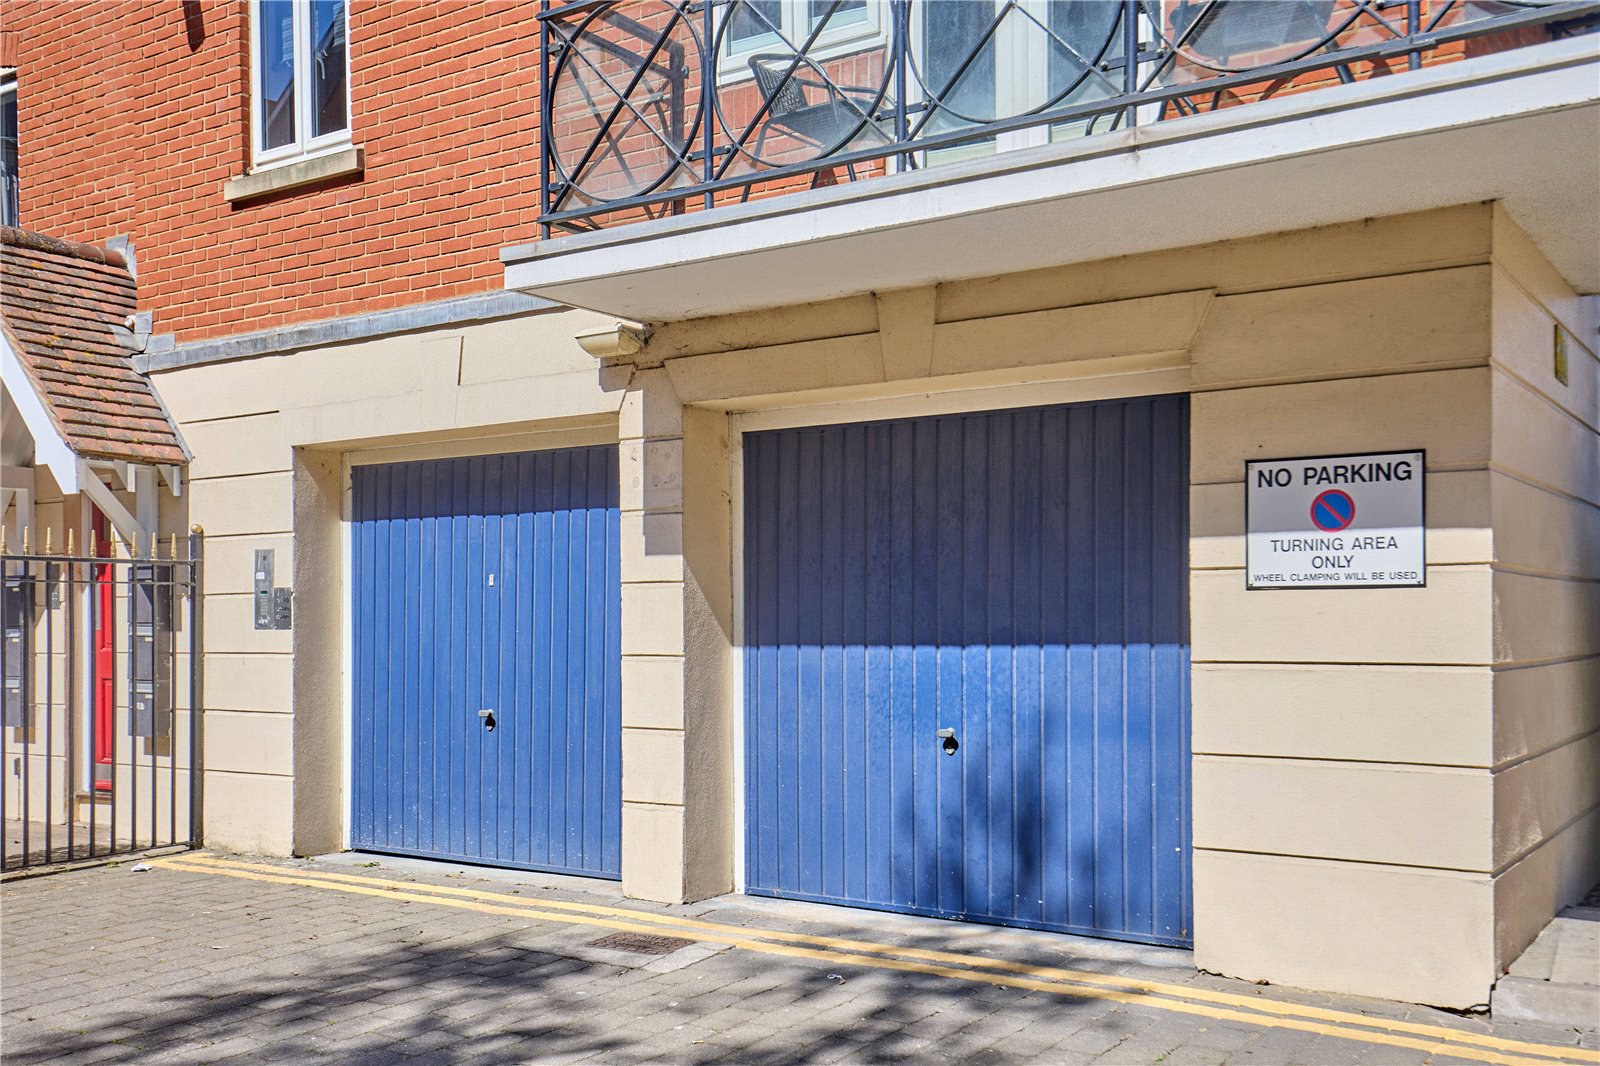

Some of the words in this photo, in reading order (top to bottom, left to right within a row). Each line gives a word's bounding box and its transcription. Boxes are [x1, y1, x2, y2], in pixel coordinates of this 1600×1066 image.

[1257, 468, 1292, 488] NO
[1303, 461, 1412, 486] PARKING
[1270, 537, 1344, 553] TURNING
[1351, 536, 1398, 550] AREA
[1311, 555, 1354, 569] ONLY
[1253, 574, 1287, 582] WHEEL
[1290, 572, 1340, 582] CLAMPING
[1345, 572, 1367, 581] WILL
[1372, 571, 1385, 580] BE
[1389, 571, 1418, 580] USED
